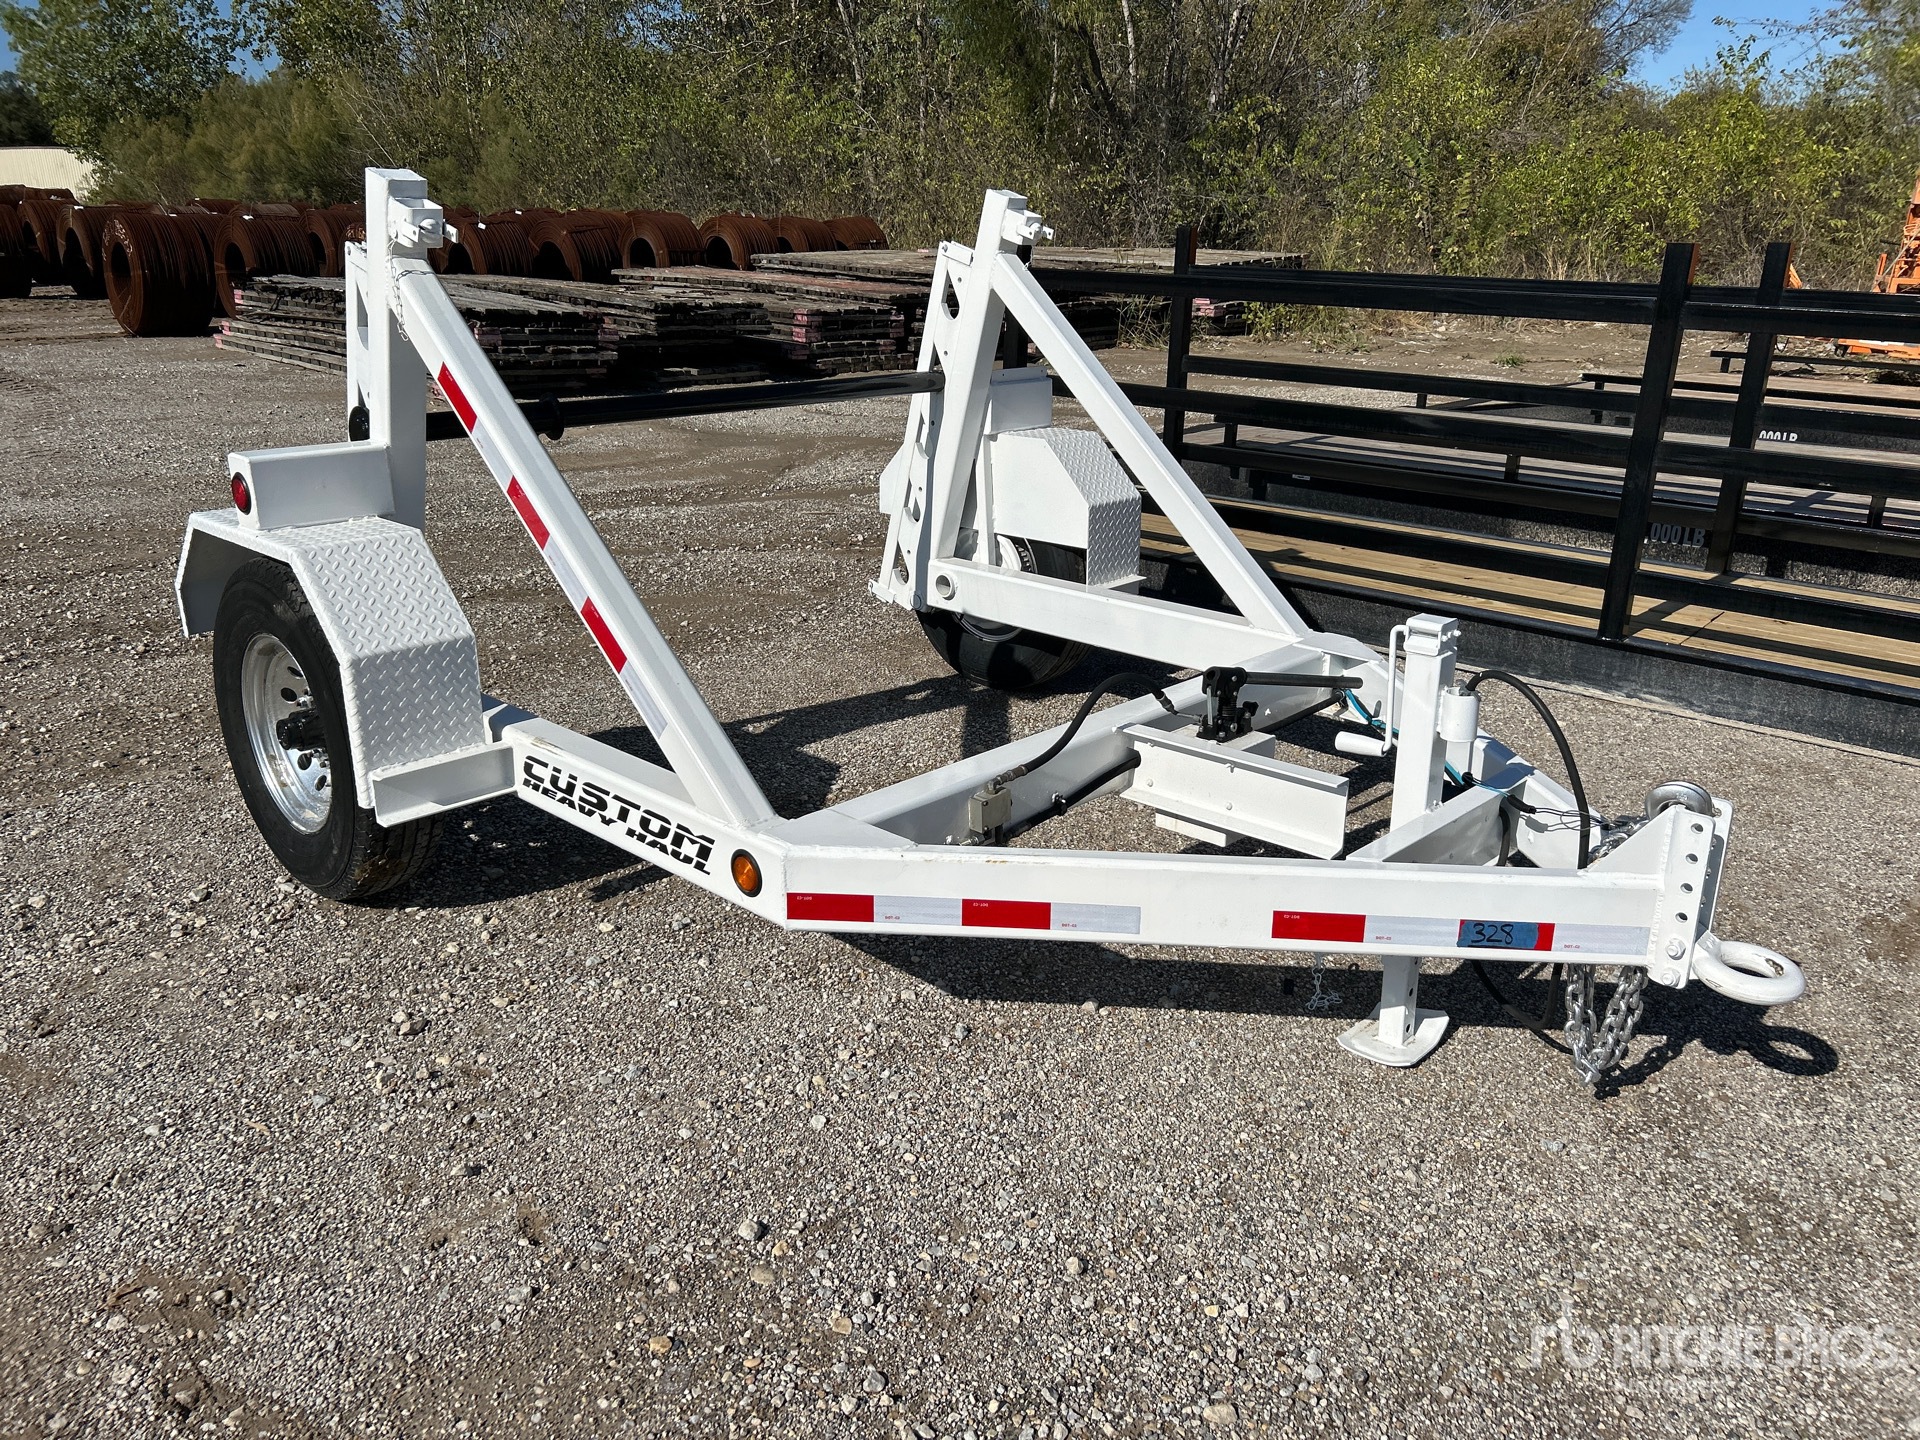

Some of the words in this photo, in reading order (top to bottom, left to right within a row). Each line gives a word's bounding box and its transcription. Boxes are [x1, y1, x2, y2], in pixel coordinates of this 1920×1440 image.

[522, 777, 618, 826] HEAVY
[625, 827, 711, 875] HAUL
[523, 755, 716, 863] CUSTOM
[1471, 923, 1513, 945] 328
